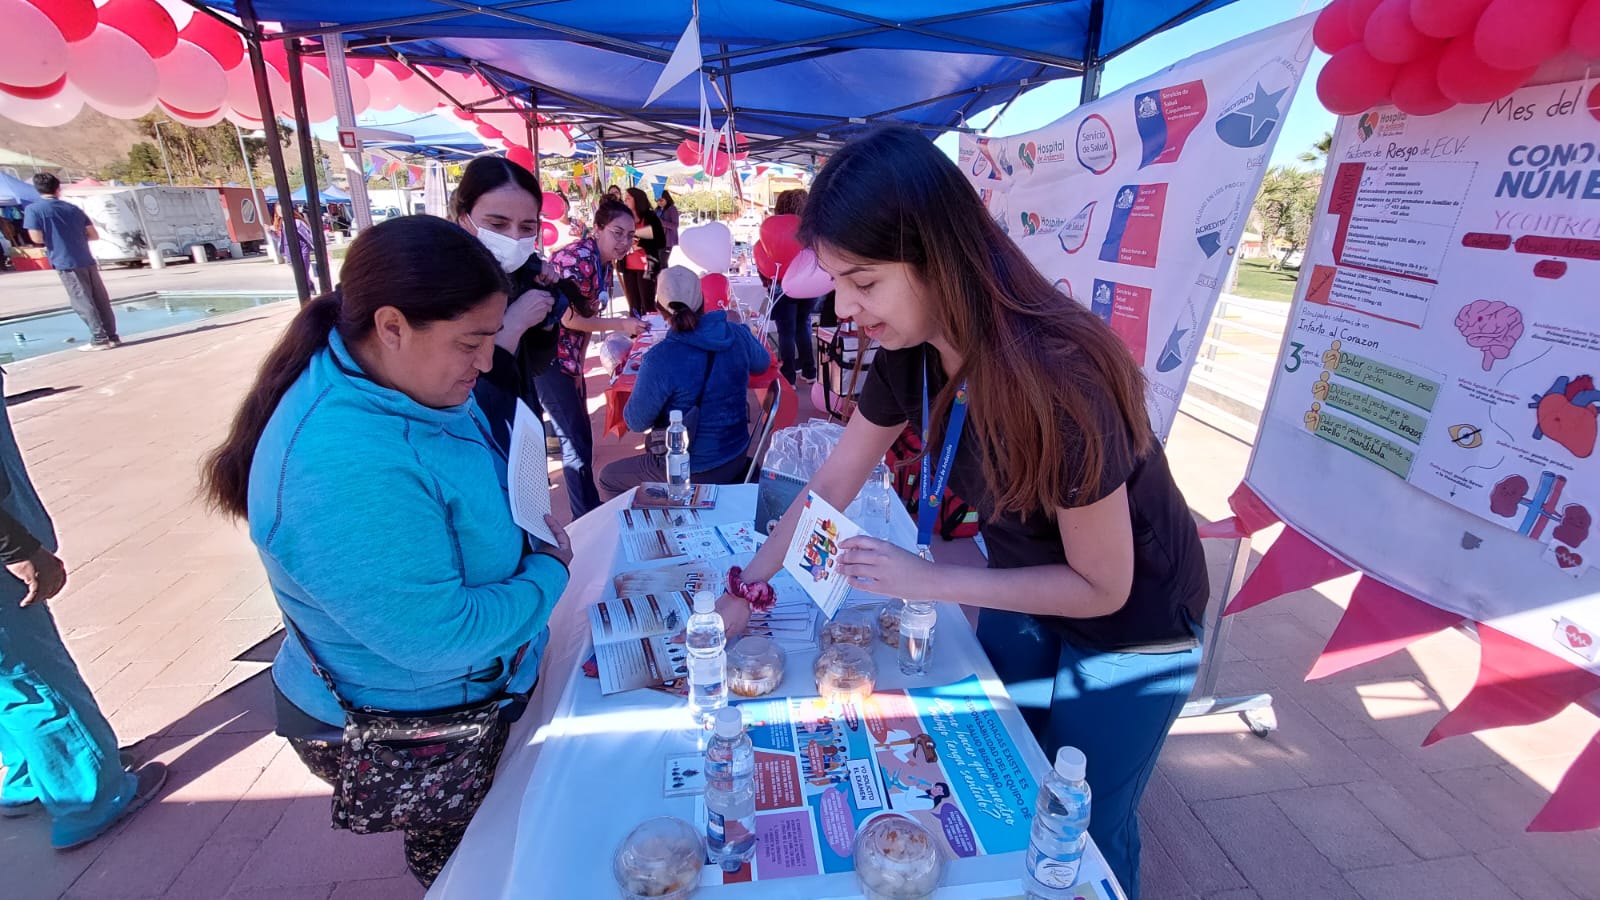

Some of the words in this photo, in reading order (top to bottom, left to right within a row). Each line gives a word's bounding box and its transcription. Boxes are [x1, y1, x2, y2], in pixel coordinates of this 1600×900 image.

[1481, 96, 1536, 125] Mes
[1546, 86, 1583, 117] del
[1037, 140, 1065, 155] Hospital
[1082, 131, 1106, 142] Servicio
[1090, 142, 1109, 153] Salud
[1386, 142, 1419, 161] Riesgo
[1298, 319, 1325, 335] Infarto
[1329, 326, 1338, 339] al
[1284, 342, 1305, 373] 3
[1340, 352, 1364, 369] Dolor
[1418, 382, 1434, 393] peso
[1364, 373, 1384, 385] pecho
[1329, 384, 1350, 398] Dolor
[1370, 400, 1388, 412] pecho
[1320, 424, 1341, 439] cuello
[1398, 422, 1423, 440] brazos
[946, 738, 965, 767] tenga
[966, 724, 983, 750] SALUD
[978, 748, 1003, 789] BUSCARLO
[861, 764, 867, 774] YO
[856, 775, 867, 801] EXAMEN
[863, 774, 875, 801] SOLICITO
[996, 757, 1007, 773] DEL
[1004, 774, 1024, 807] EQUIPO
[1020, 806, 1032, 820] DE
[1018, 778, 1029, 791] ES
[986, 782, 1015, 826] nuestro
